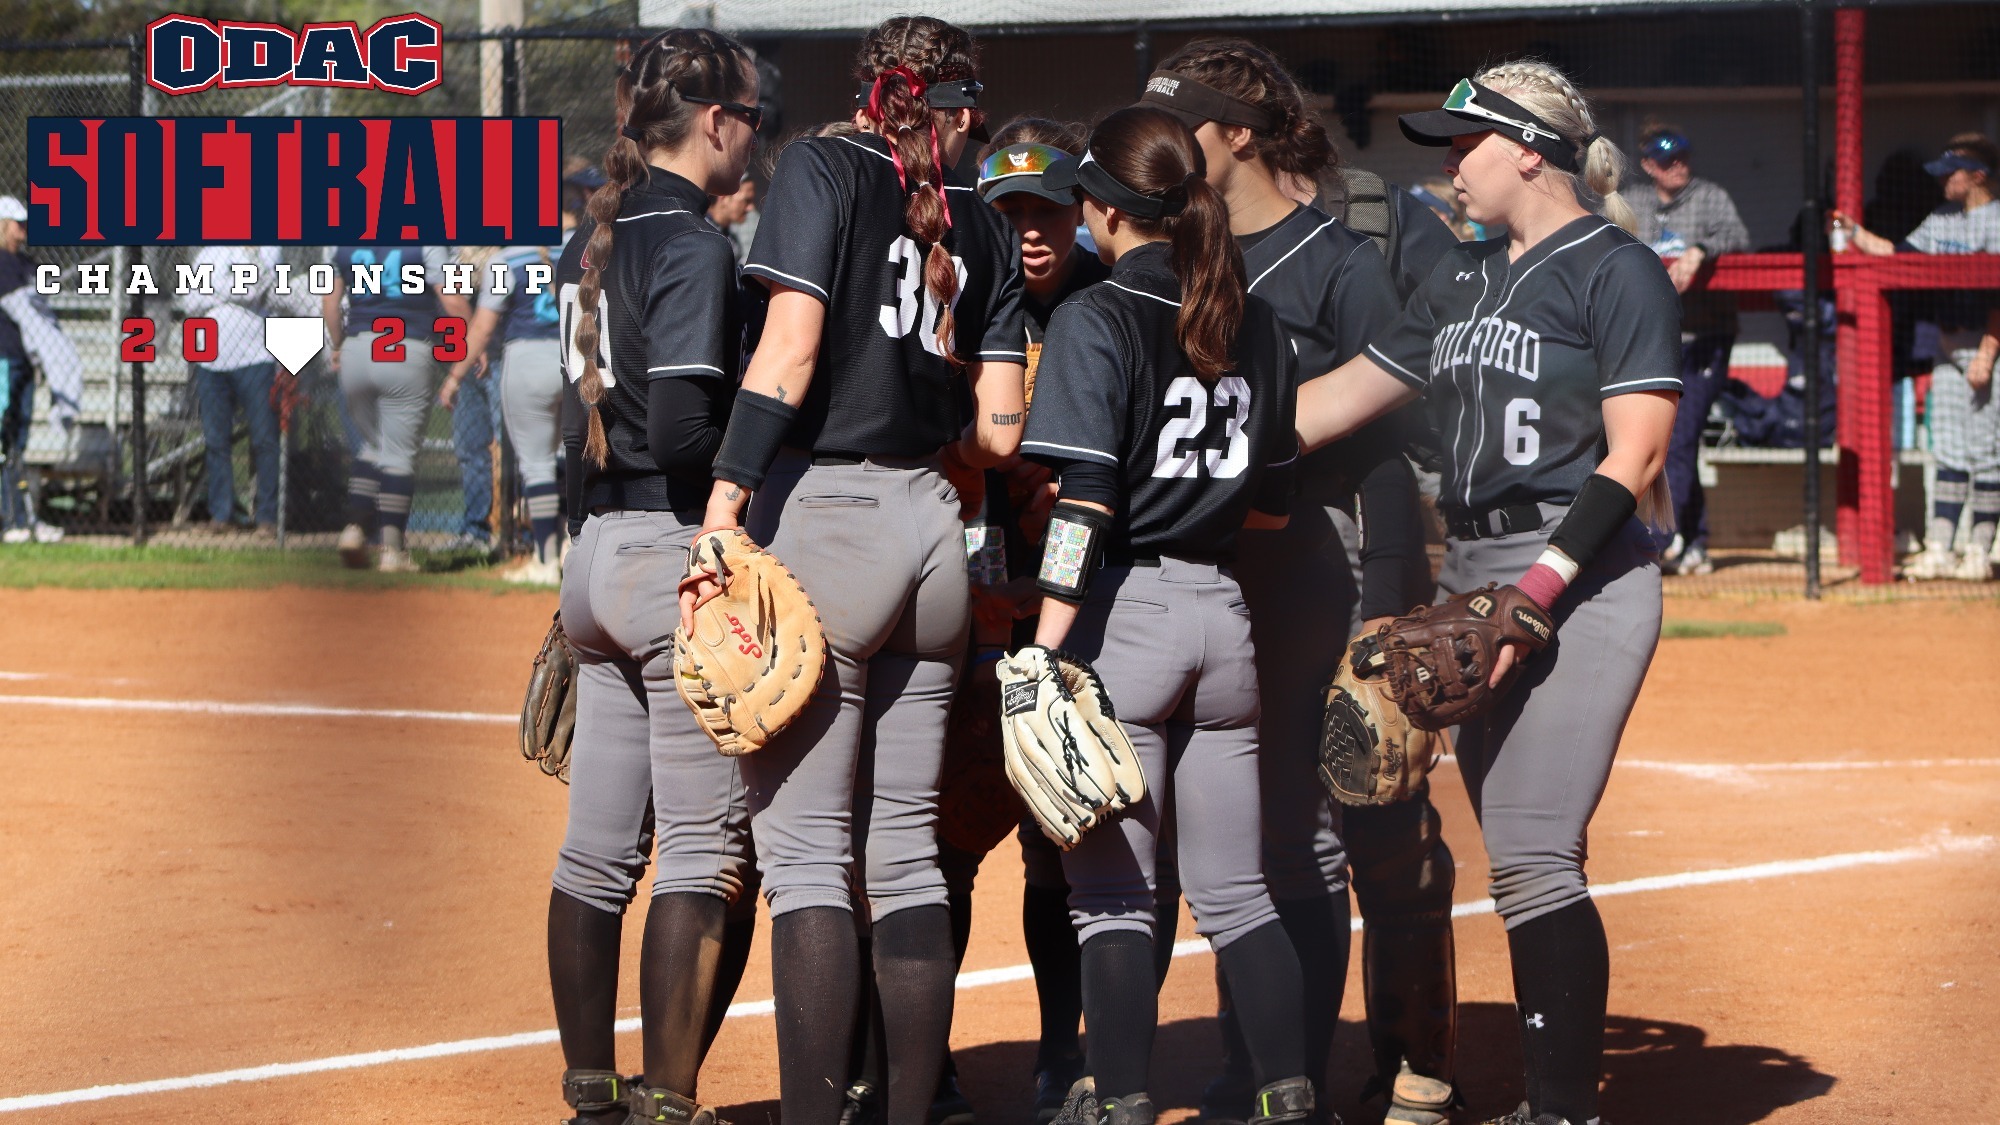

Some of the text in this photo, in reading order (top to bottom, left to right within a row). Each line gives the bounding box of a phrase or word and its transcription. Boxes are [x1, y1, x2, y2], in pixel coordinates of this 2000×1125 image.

[1151, 377, 1251, 479] 23
[1503, 398, 1541, 466] 6
[724, 613, 763, 659] Soto
[1517, 609, 1550, 641] Wilson
[1382, 737, 1400, 781] Rawlings
